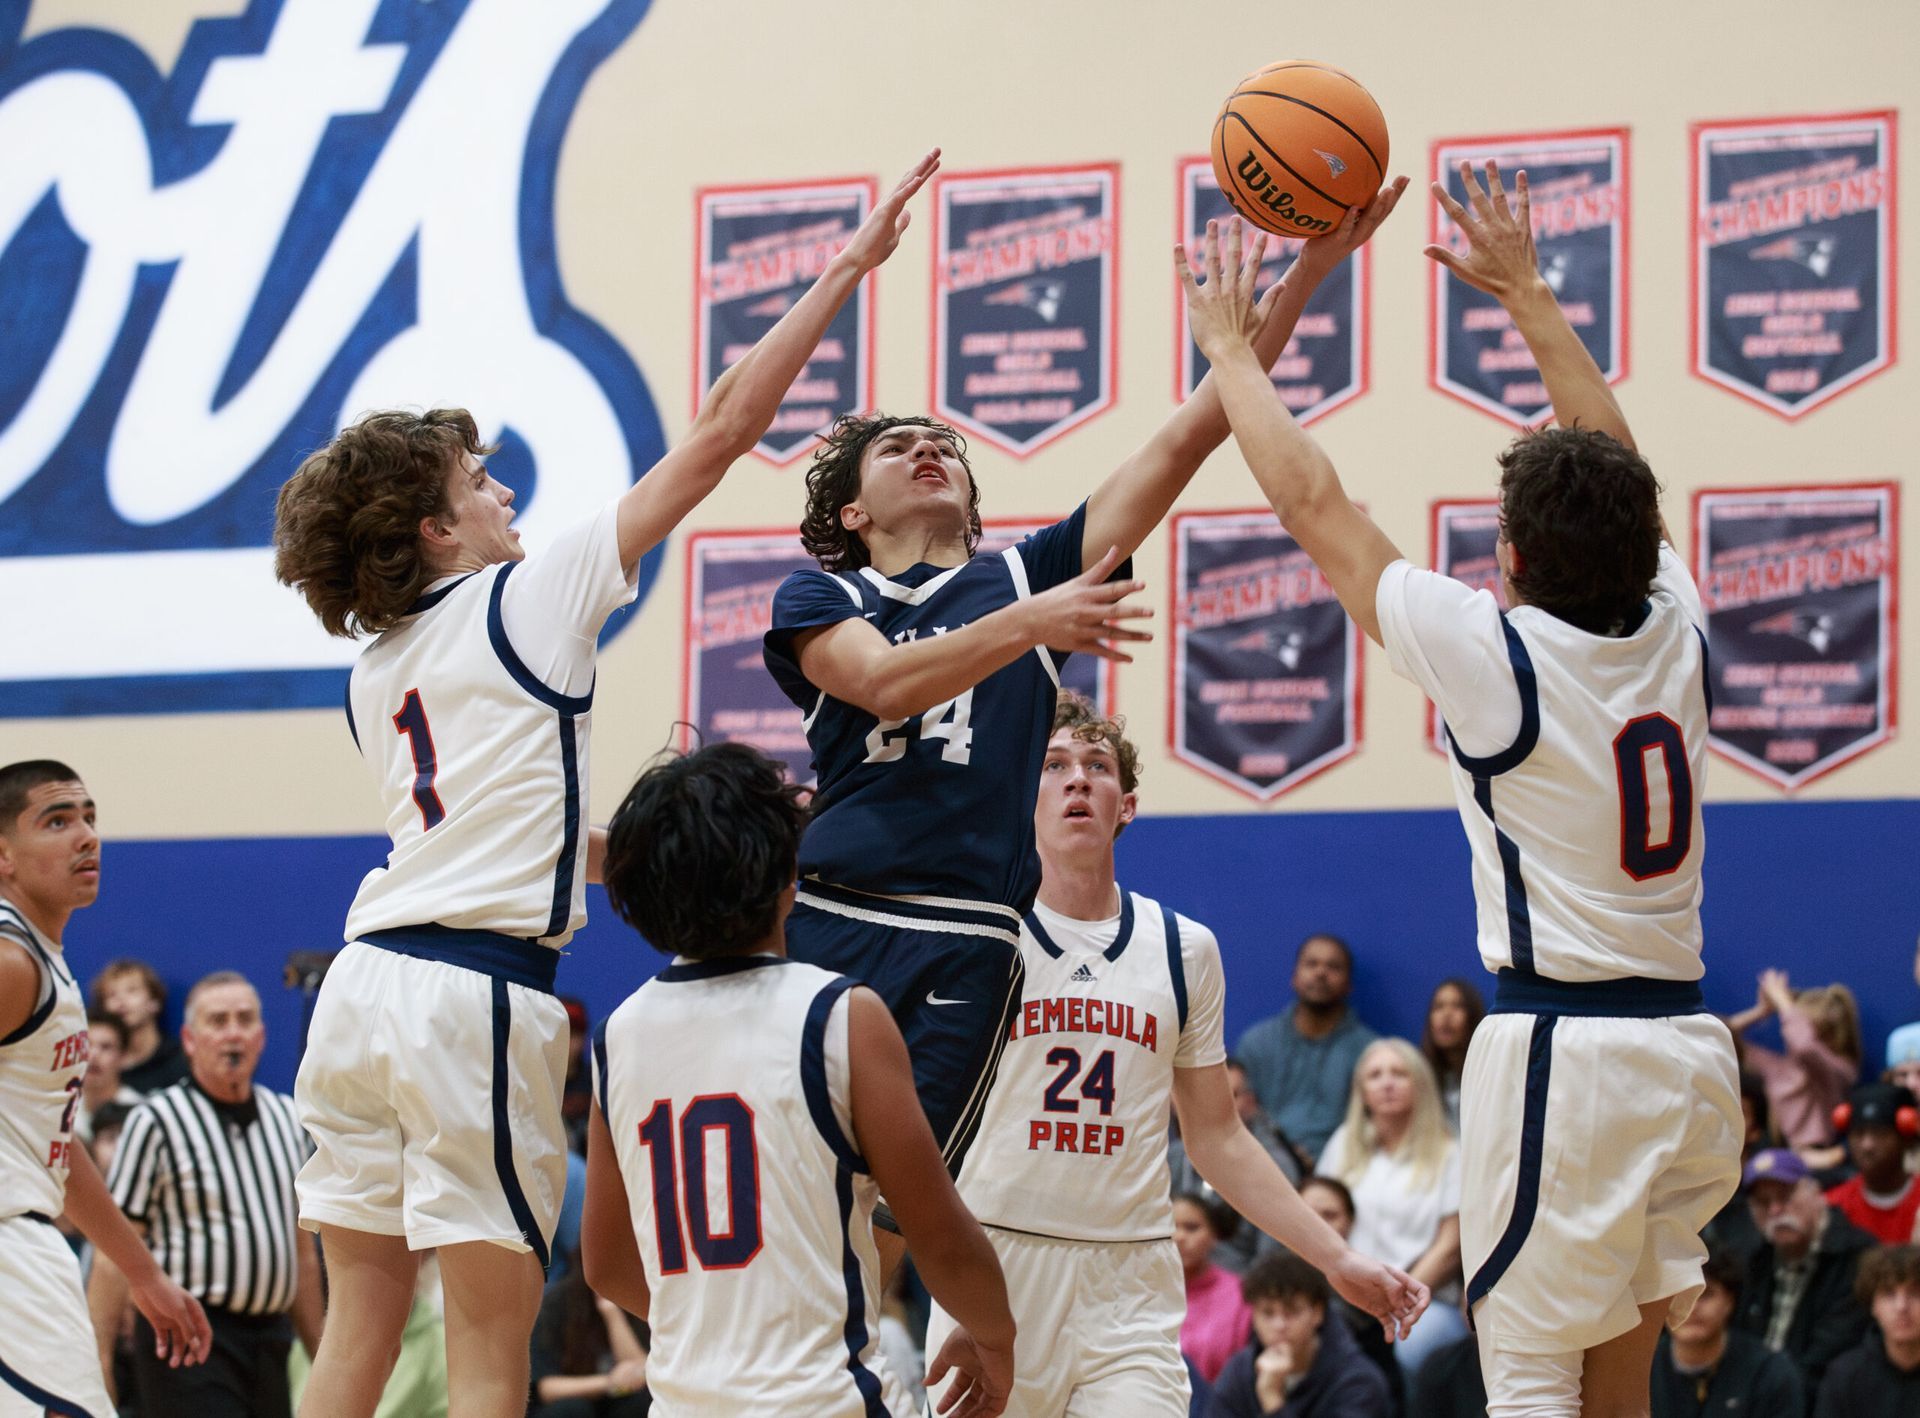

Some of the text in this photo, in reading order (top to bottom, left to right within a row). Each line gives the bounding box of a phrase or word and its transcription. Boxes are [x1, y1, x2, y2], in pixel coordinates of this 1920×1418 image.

[1237, 150, 1333, 232] Wilson
[1701, 165, 1886, 247] CHAMPIONS
[939, 215, 1114, 292] CHAMPIONS
[1701, 537, 1889, 614] CHAMPIONS
[392, 687, 446, 833] 1
[1612, 711, 1694, 883] 0
[1043, 1046, 1117, 1117] 24
[1027, 1120, 1125, 1156] PREP
[637, 1092, 765, 1277] 10
